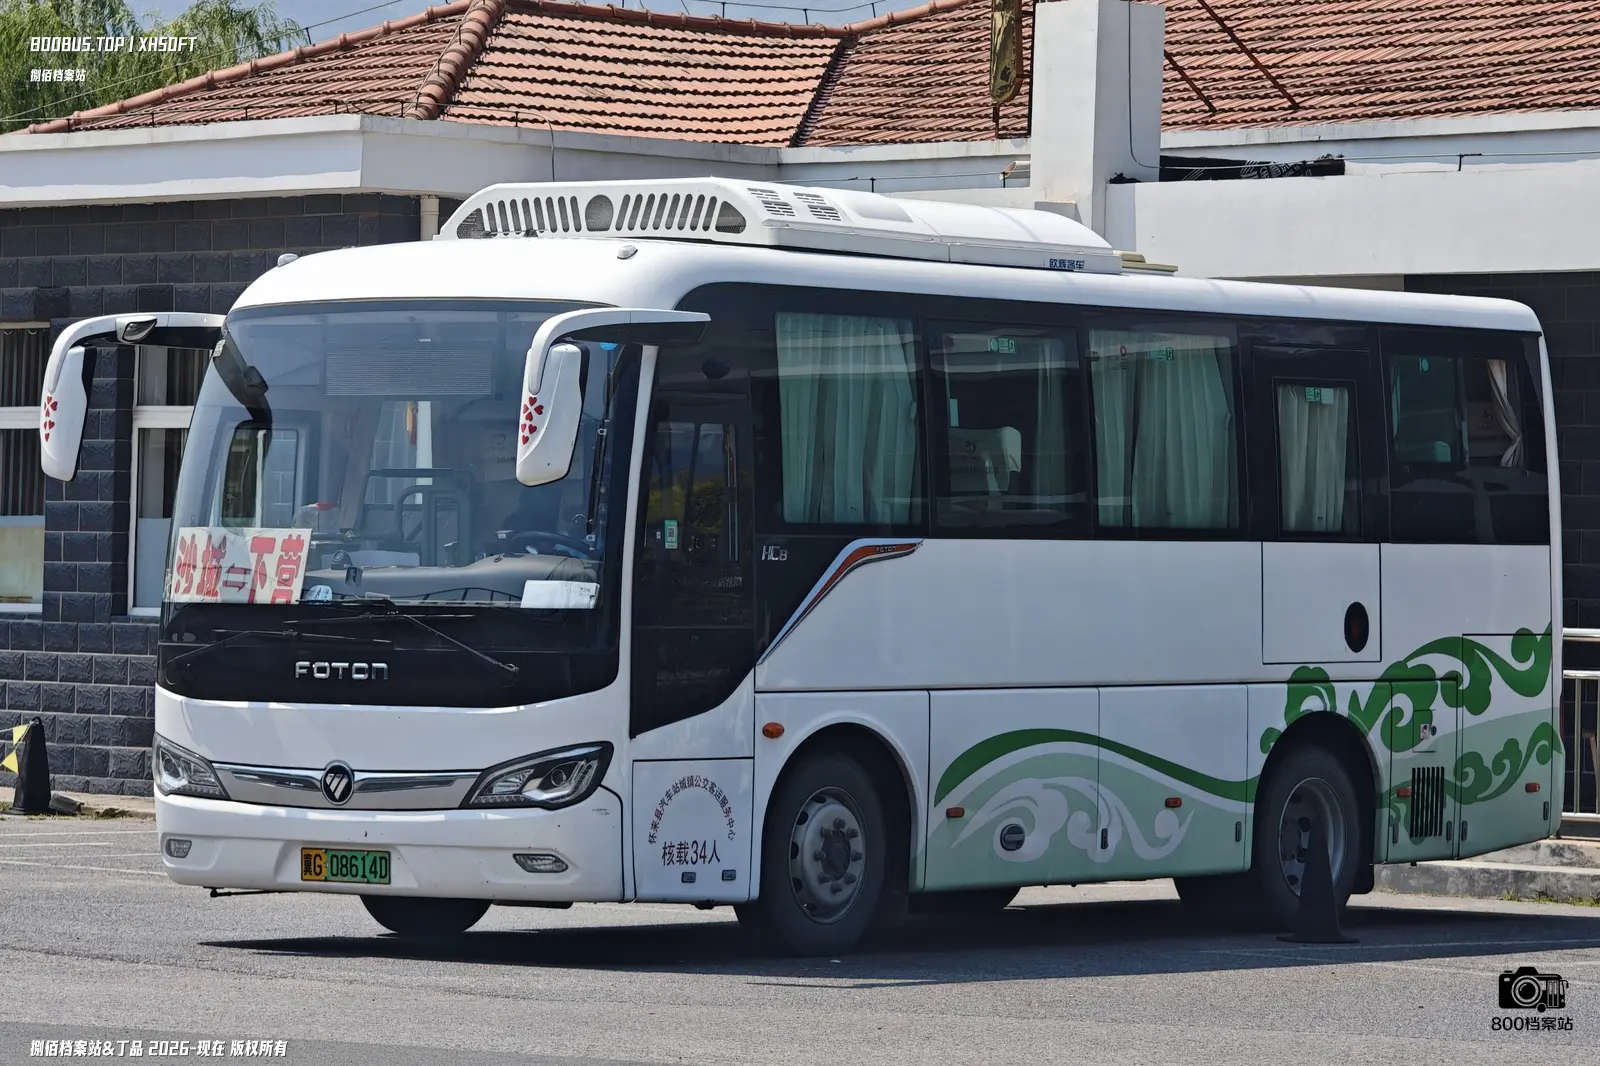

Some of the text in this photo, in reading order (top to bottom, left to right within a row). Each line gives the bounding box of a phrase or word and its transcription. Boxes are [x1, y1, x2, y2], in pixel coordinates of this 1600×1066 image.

[295, 661, 388, 680] FOTON
[661, 839, 721, 867] 核载34人
